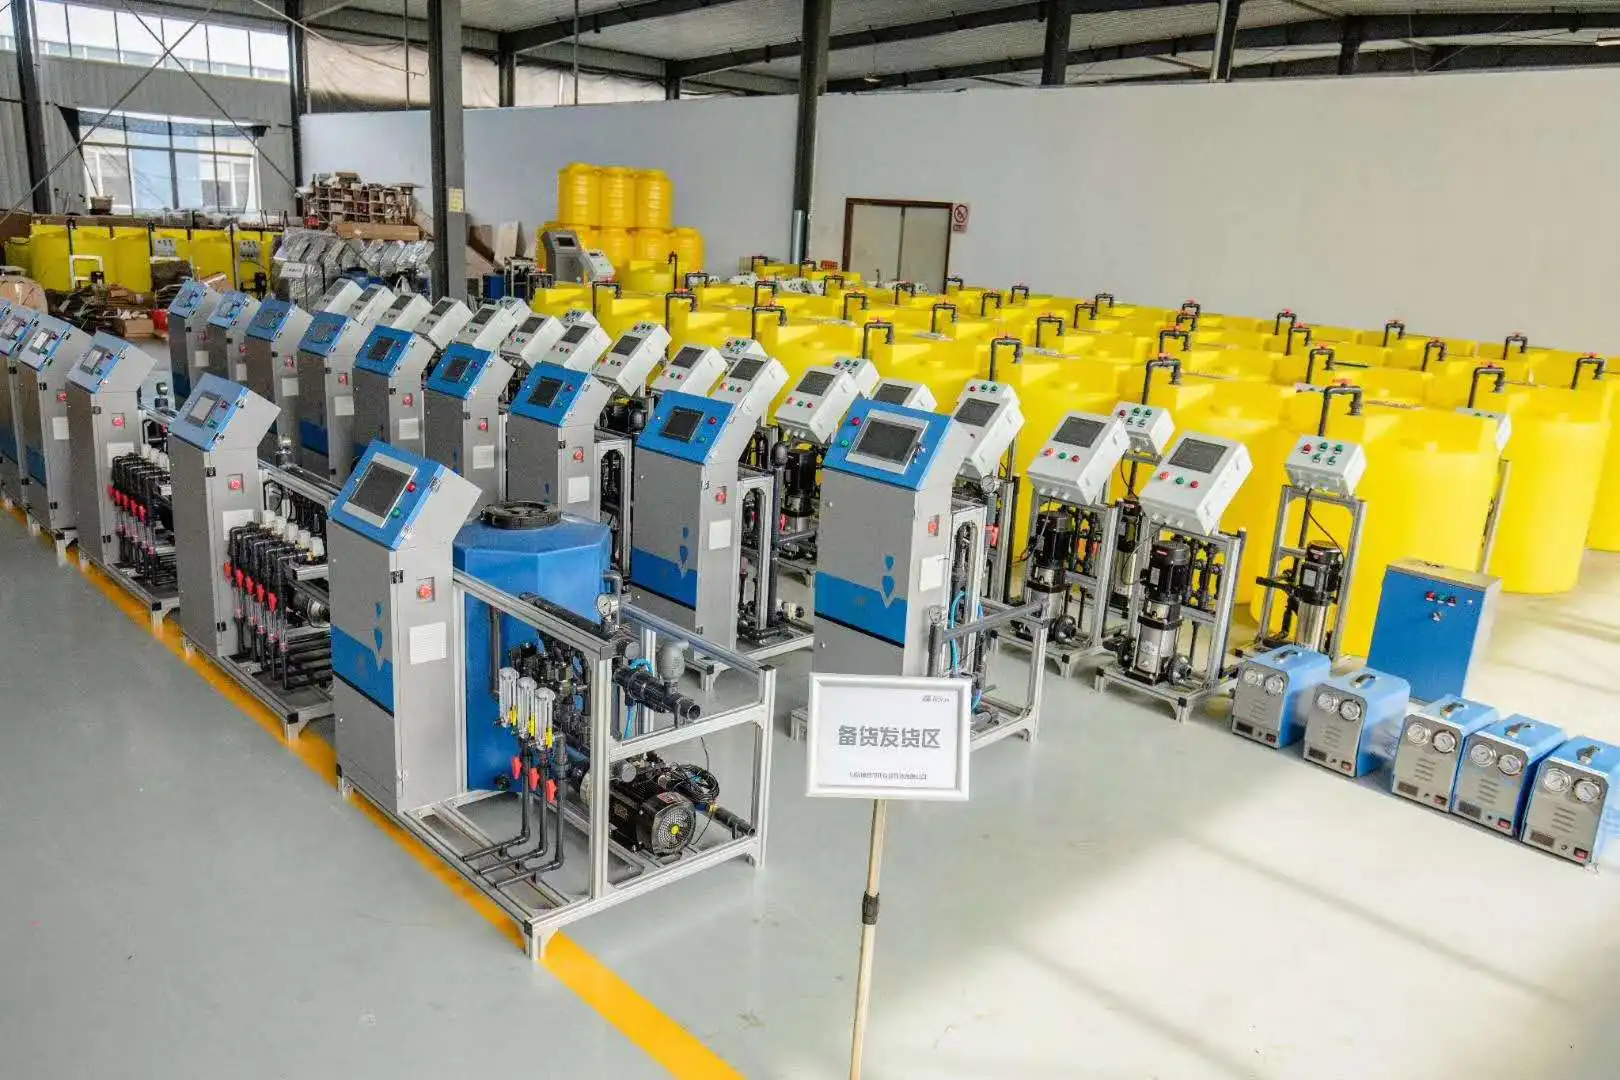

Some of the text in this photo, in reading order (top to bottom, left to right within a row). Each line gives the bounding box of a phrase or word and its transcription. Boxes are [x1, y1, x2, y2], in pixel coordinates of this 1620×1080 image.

[838, 724, 942, 749] 备货发货区
